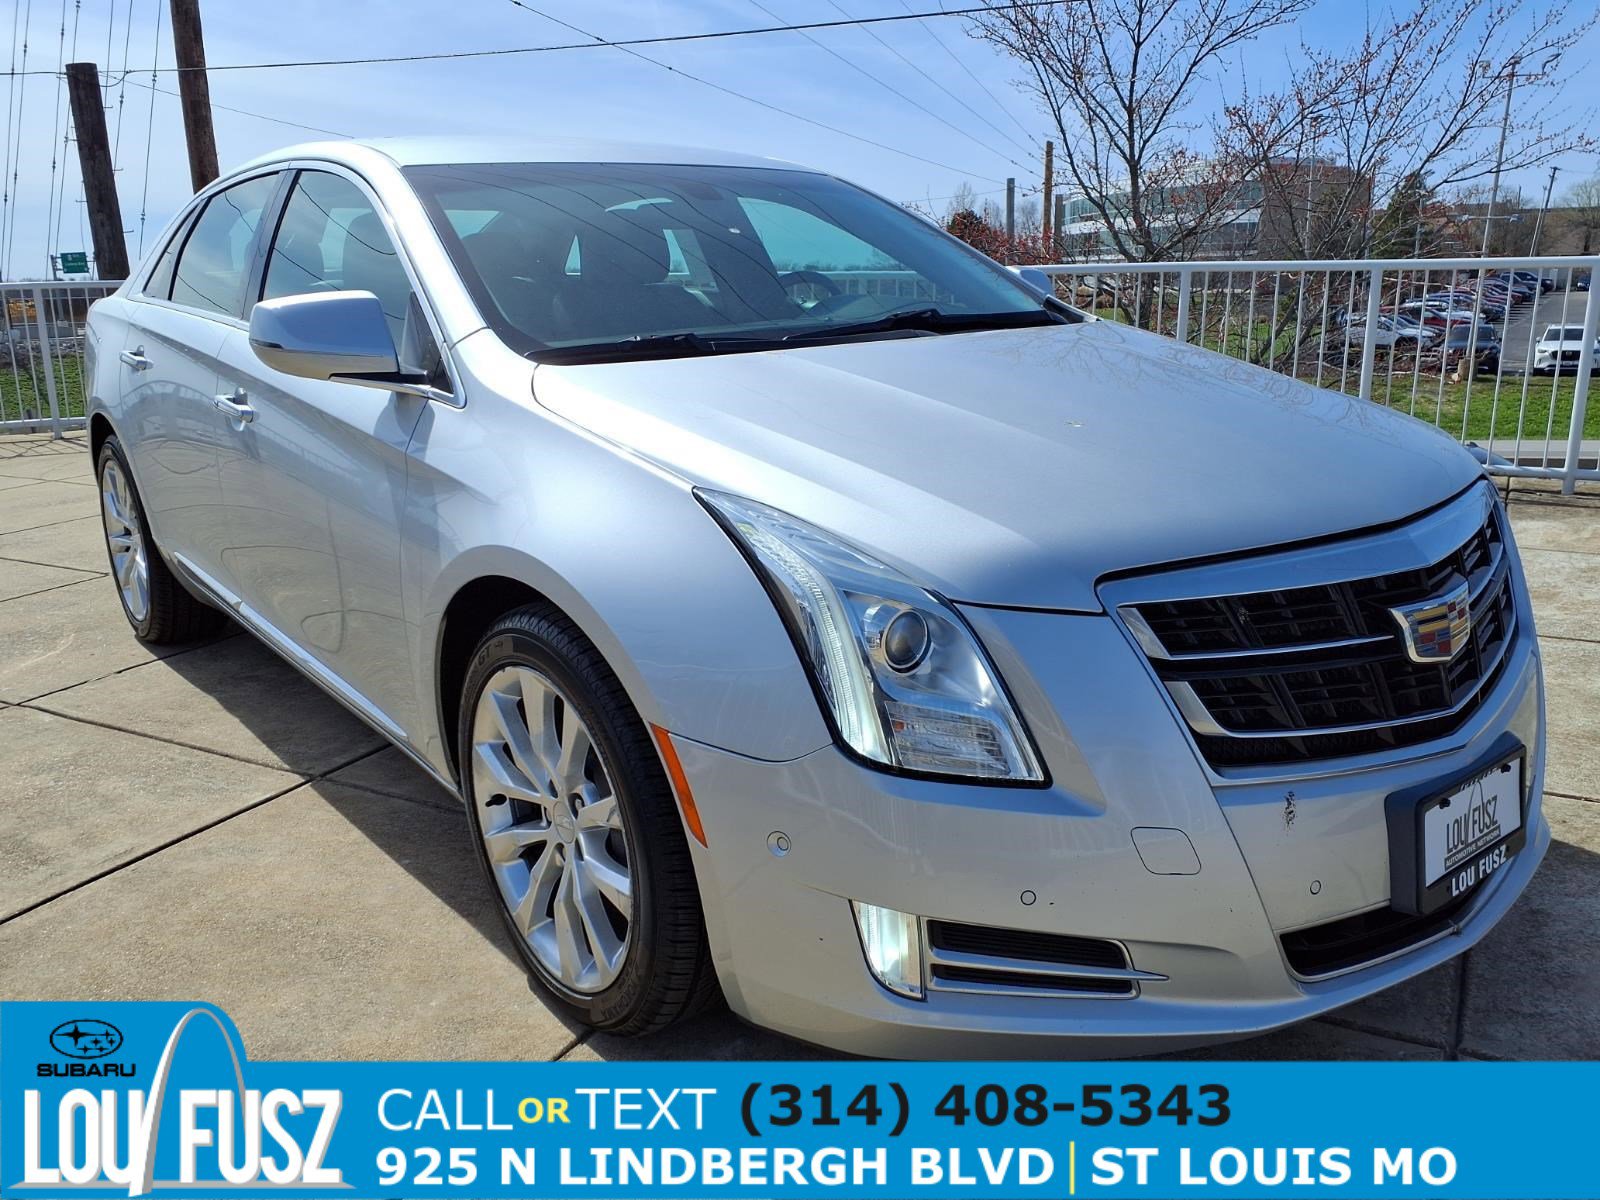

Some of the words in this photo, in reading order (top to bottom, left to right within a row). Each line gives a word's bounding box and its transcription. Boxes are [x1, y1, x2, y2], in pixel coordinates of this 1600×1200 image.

[1445, 843, 1477, 867] AUTOMOTIVE
[1477, 829, 1500, 850] NETWORK
[1446, 814, 1469, 854] LOU
[1472, 795, 1498, 838] FUSZ
[1451, 865, 1475, 897] LOU
[1479, 844, 1507, 879] FUSZ
